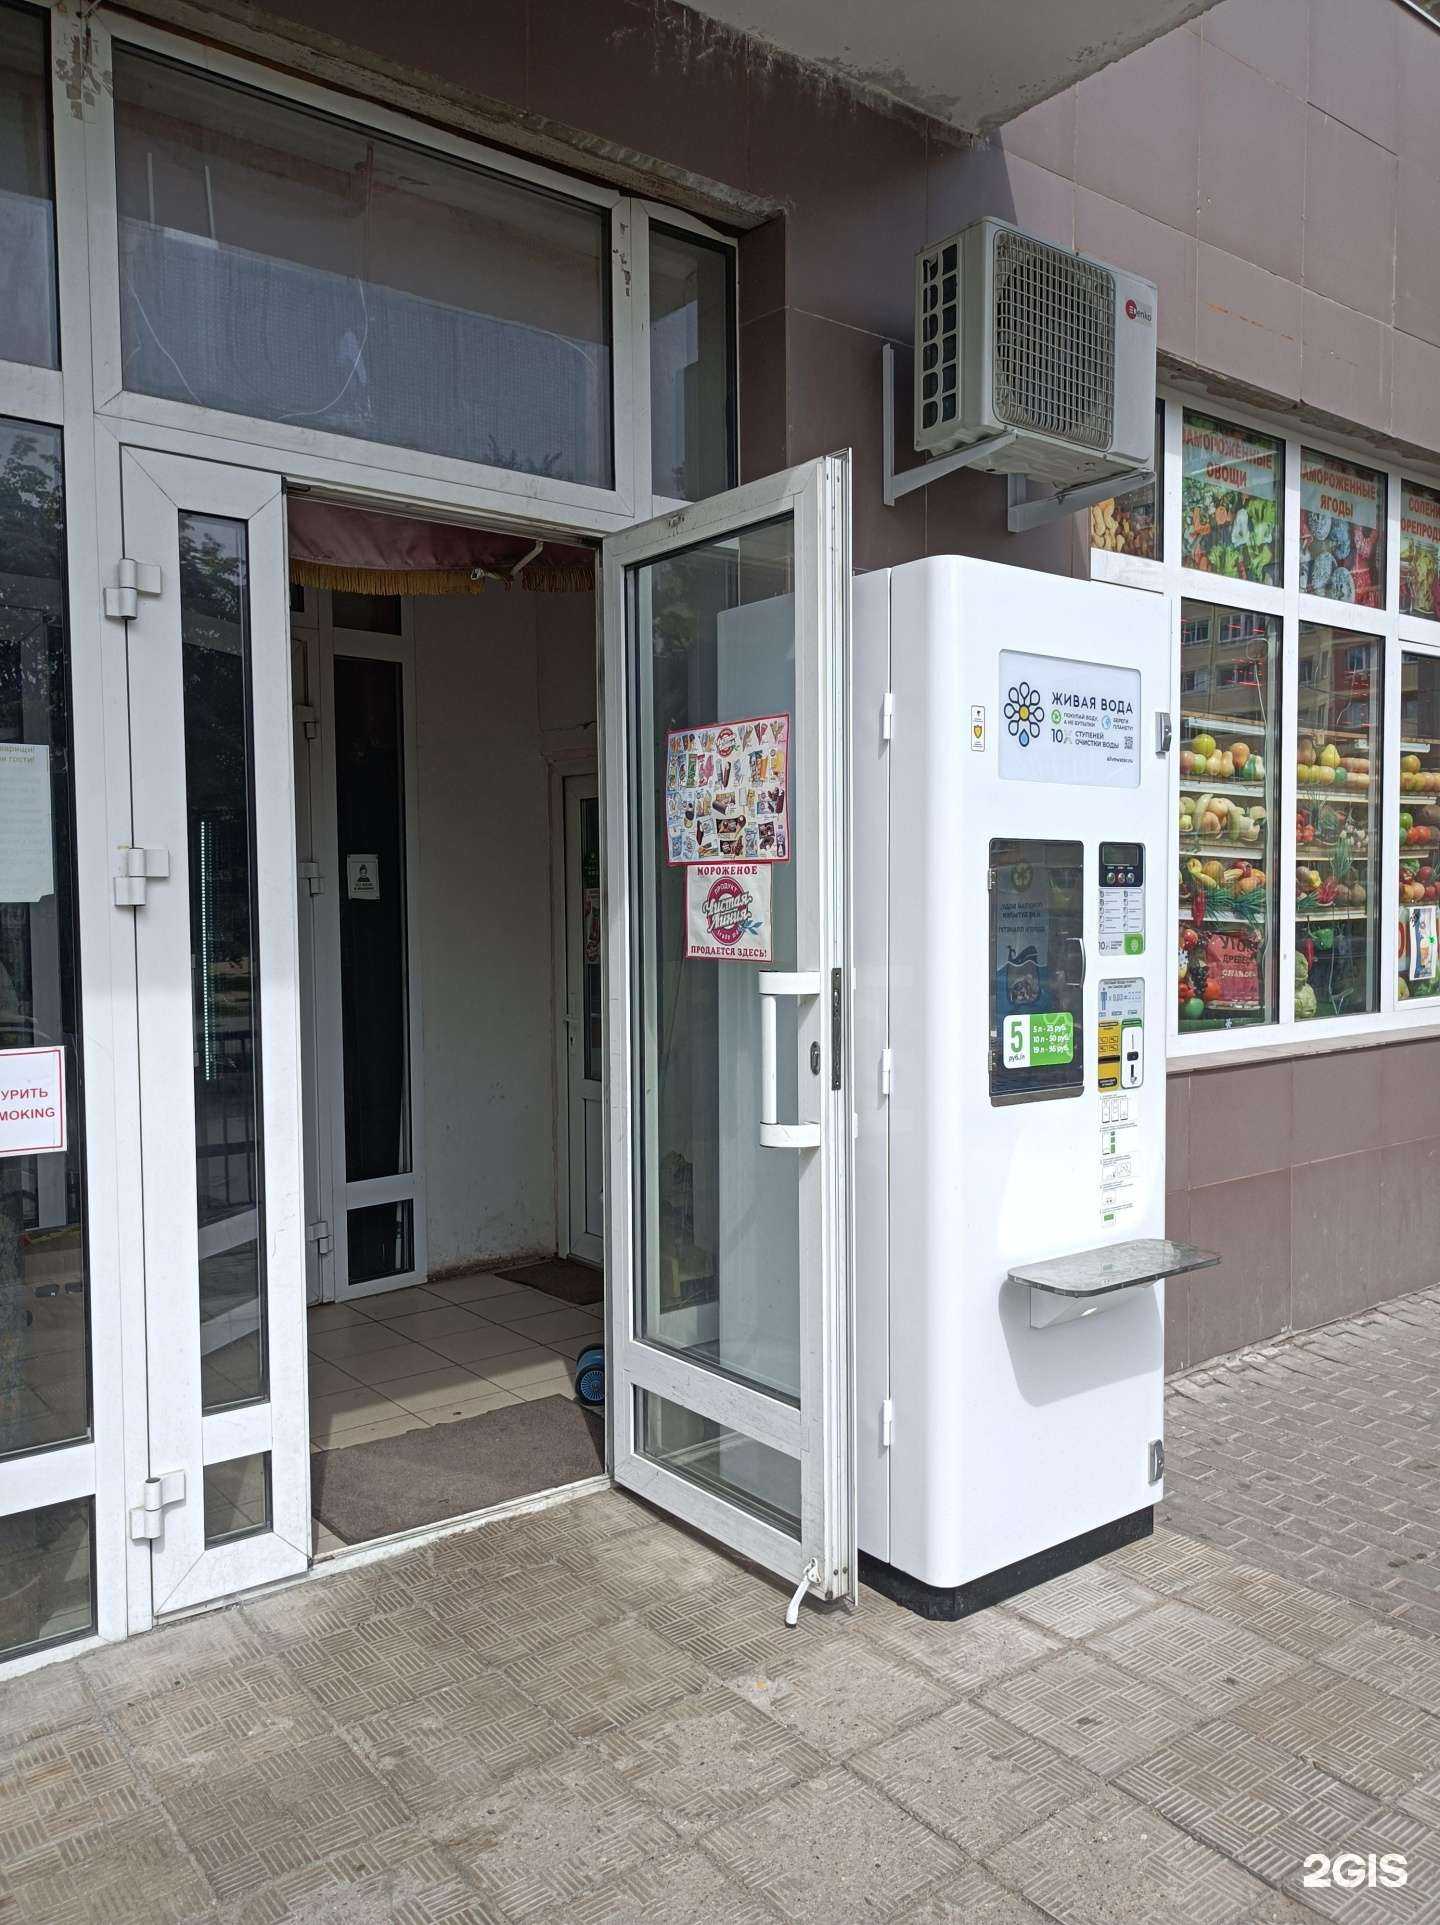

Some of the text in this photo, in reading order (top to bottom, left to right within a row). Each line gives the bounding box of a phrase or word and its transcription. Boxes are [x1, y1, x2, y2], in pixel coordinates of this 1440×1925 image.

[1206, 462, 1247, 489] ОВОЩИ
[1301, 463, 1376, 500] АМОРОЖЕННЫЕ
[1320, 494, 1354, 518] ЯГОДЫ
[1401, 518, 1440, 543] ОРЕПРОД
[1052, 691, 1133, 715] ЖИВАЯ ВОДА
[1051, 728, 1064, 743] 10
[1075, 730, 1104, 740] СТУПЕНЕЙ
[1075, 739, 1120, 749] ОЧИСТКИ ВОДЫ
[697, 865, 758, 876] МОРОЖЕНОЕ
[691, 946, 767, 958] ПРОДАЕТСЯ ЗДЕСЬ!
[1011, 1021, 1023, 1053] 5
[0, 1087, 48, 1101] УРИТЬ
[0, 1107, 55, 1121] MOKING
